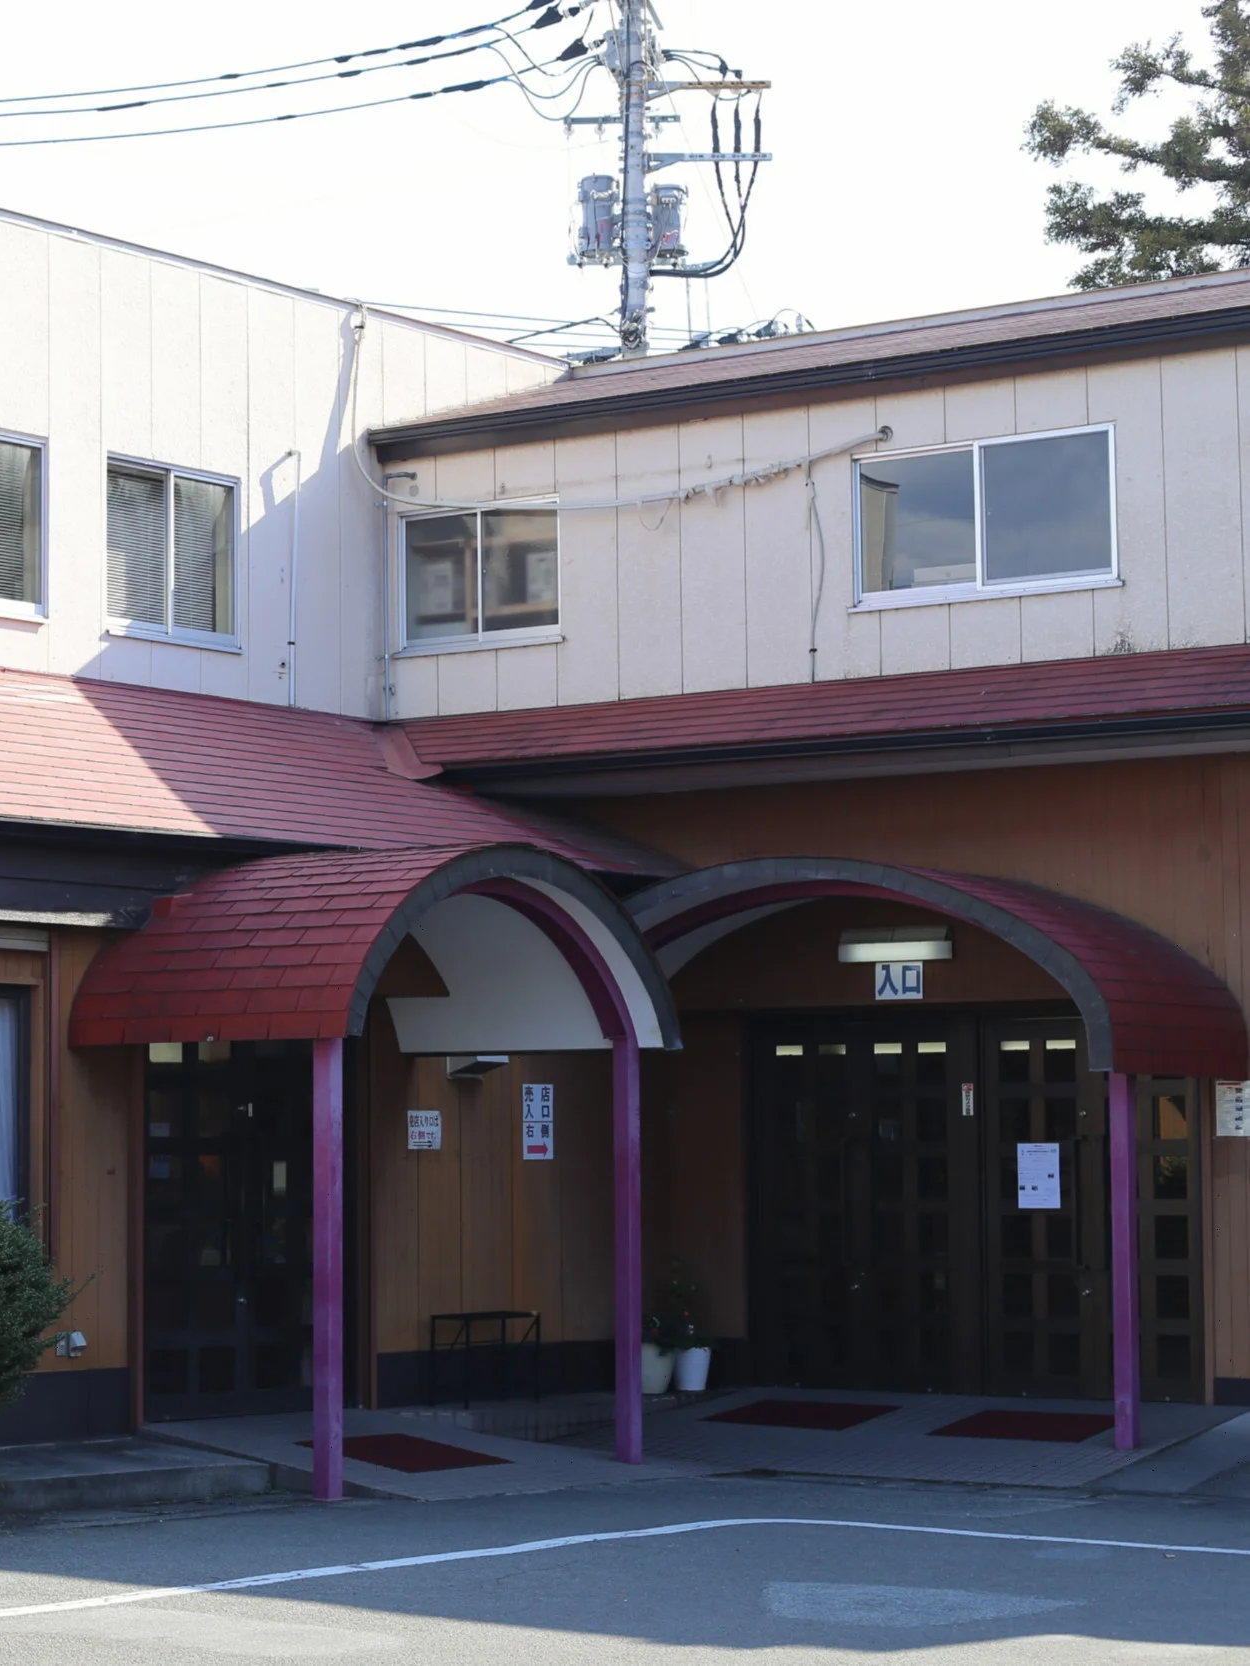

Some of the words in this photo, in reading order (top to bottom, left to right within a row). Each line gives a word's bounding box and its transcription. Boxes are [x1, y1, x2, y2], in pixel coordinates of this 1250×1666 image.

[877, 964, 921, 996] 入口
[524, 1086, 551, 1103] 売店
[524, 1104, 551, 1120] 入口
[525, 1124, 550, 1139] 右側
